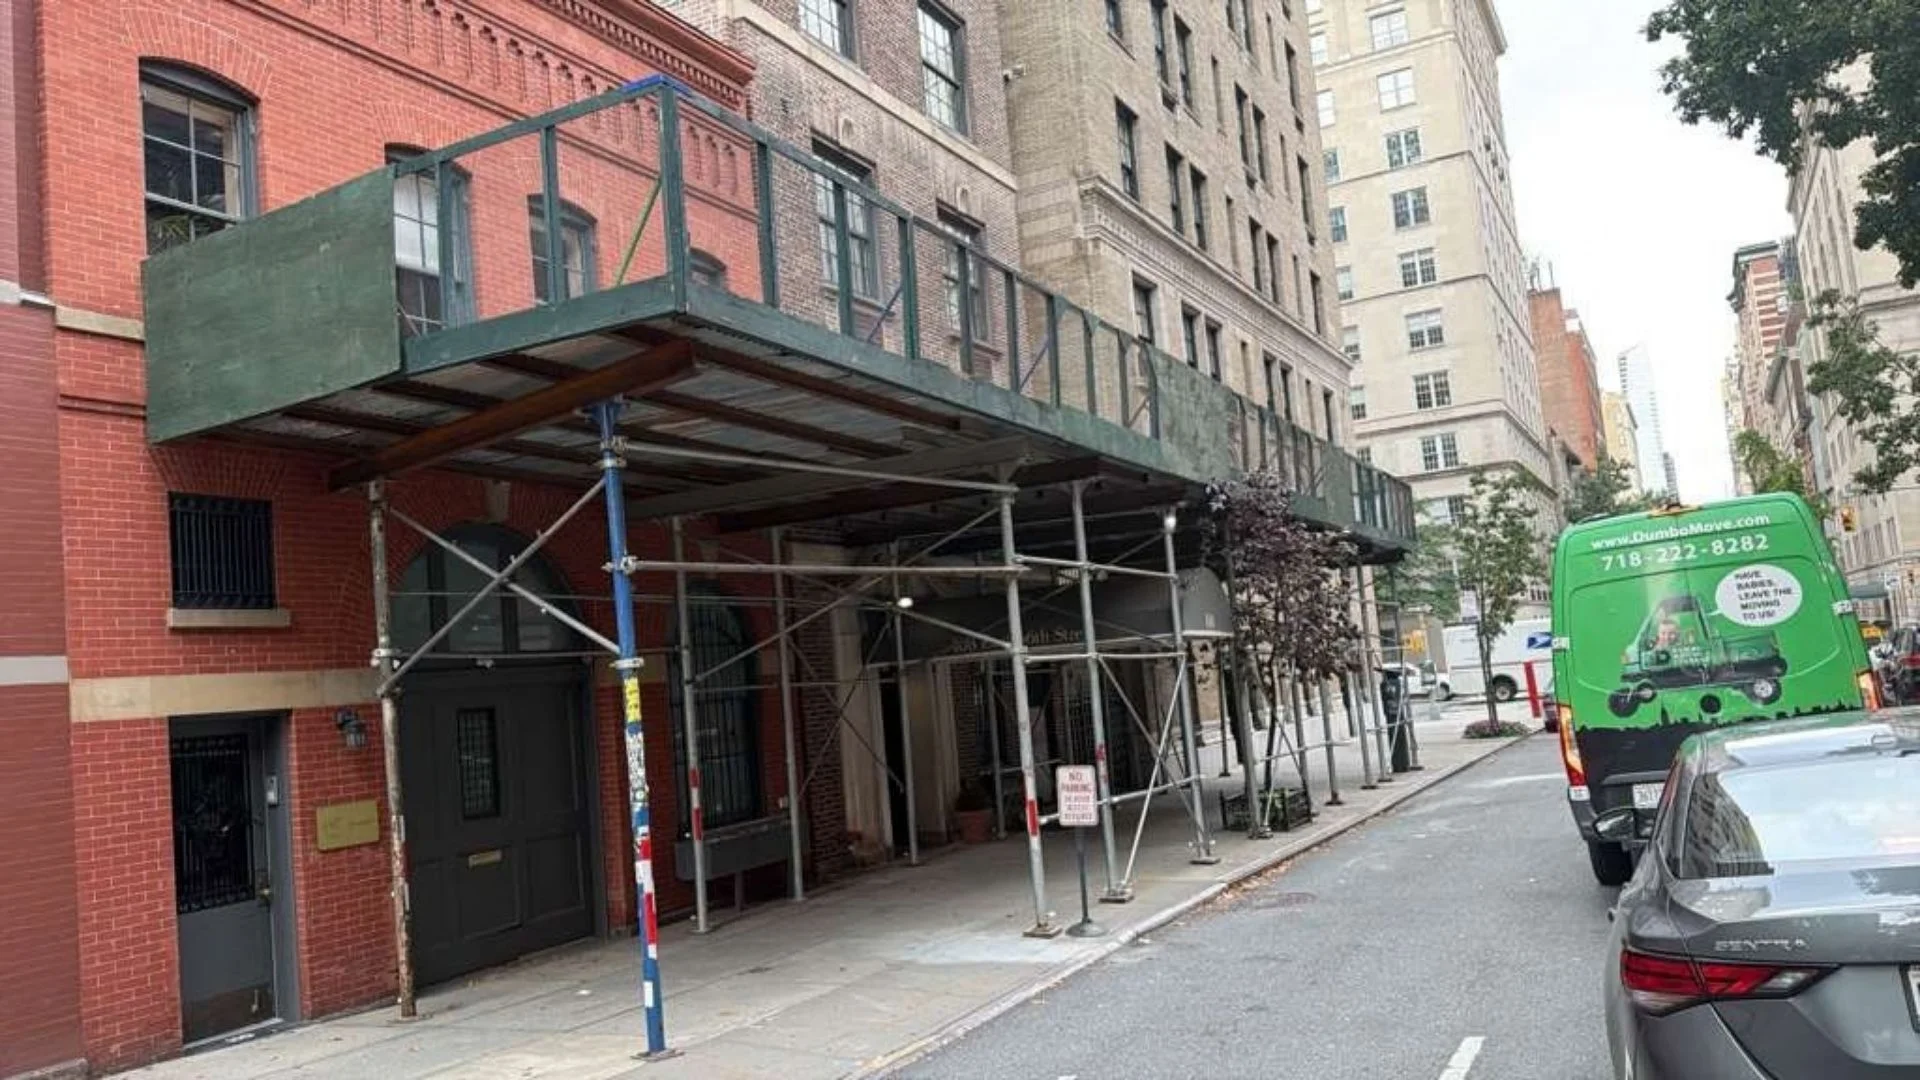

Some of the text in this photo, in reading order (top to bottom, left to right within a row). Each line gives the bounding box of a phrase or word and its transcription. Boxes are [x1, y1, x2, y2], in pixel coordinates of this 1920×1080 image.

[1591, 513, 1770, 550] www.DumboMove.com
[1735, 570, 1761, 580] HAVE
[1738, 587, 1792, 601] LEAVE THE
[1740, 599, 1780, 610] MOVING
[1743, 612, 1756, 620] TO
[1068, 772, 1083, 781] NO
[1714, 938, 1809, 952] SENTRA
